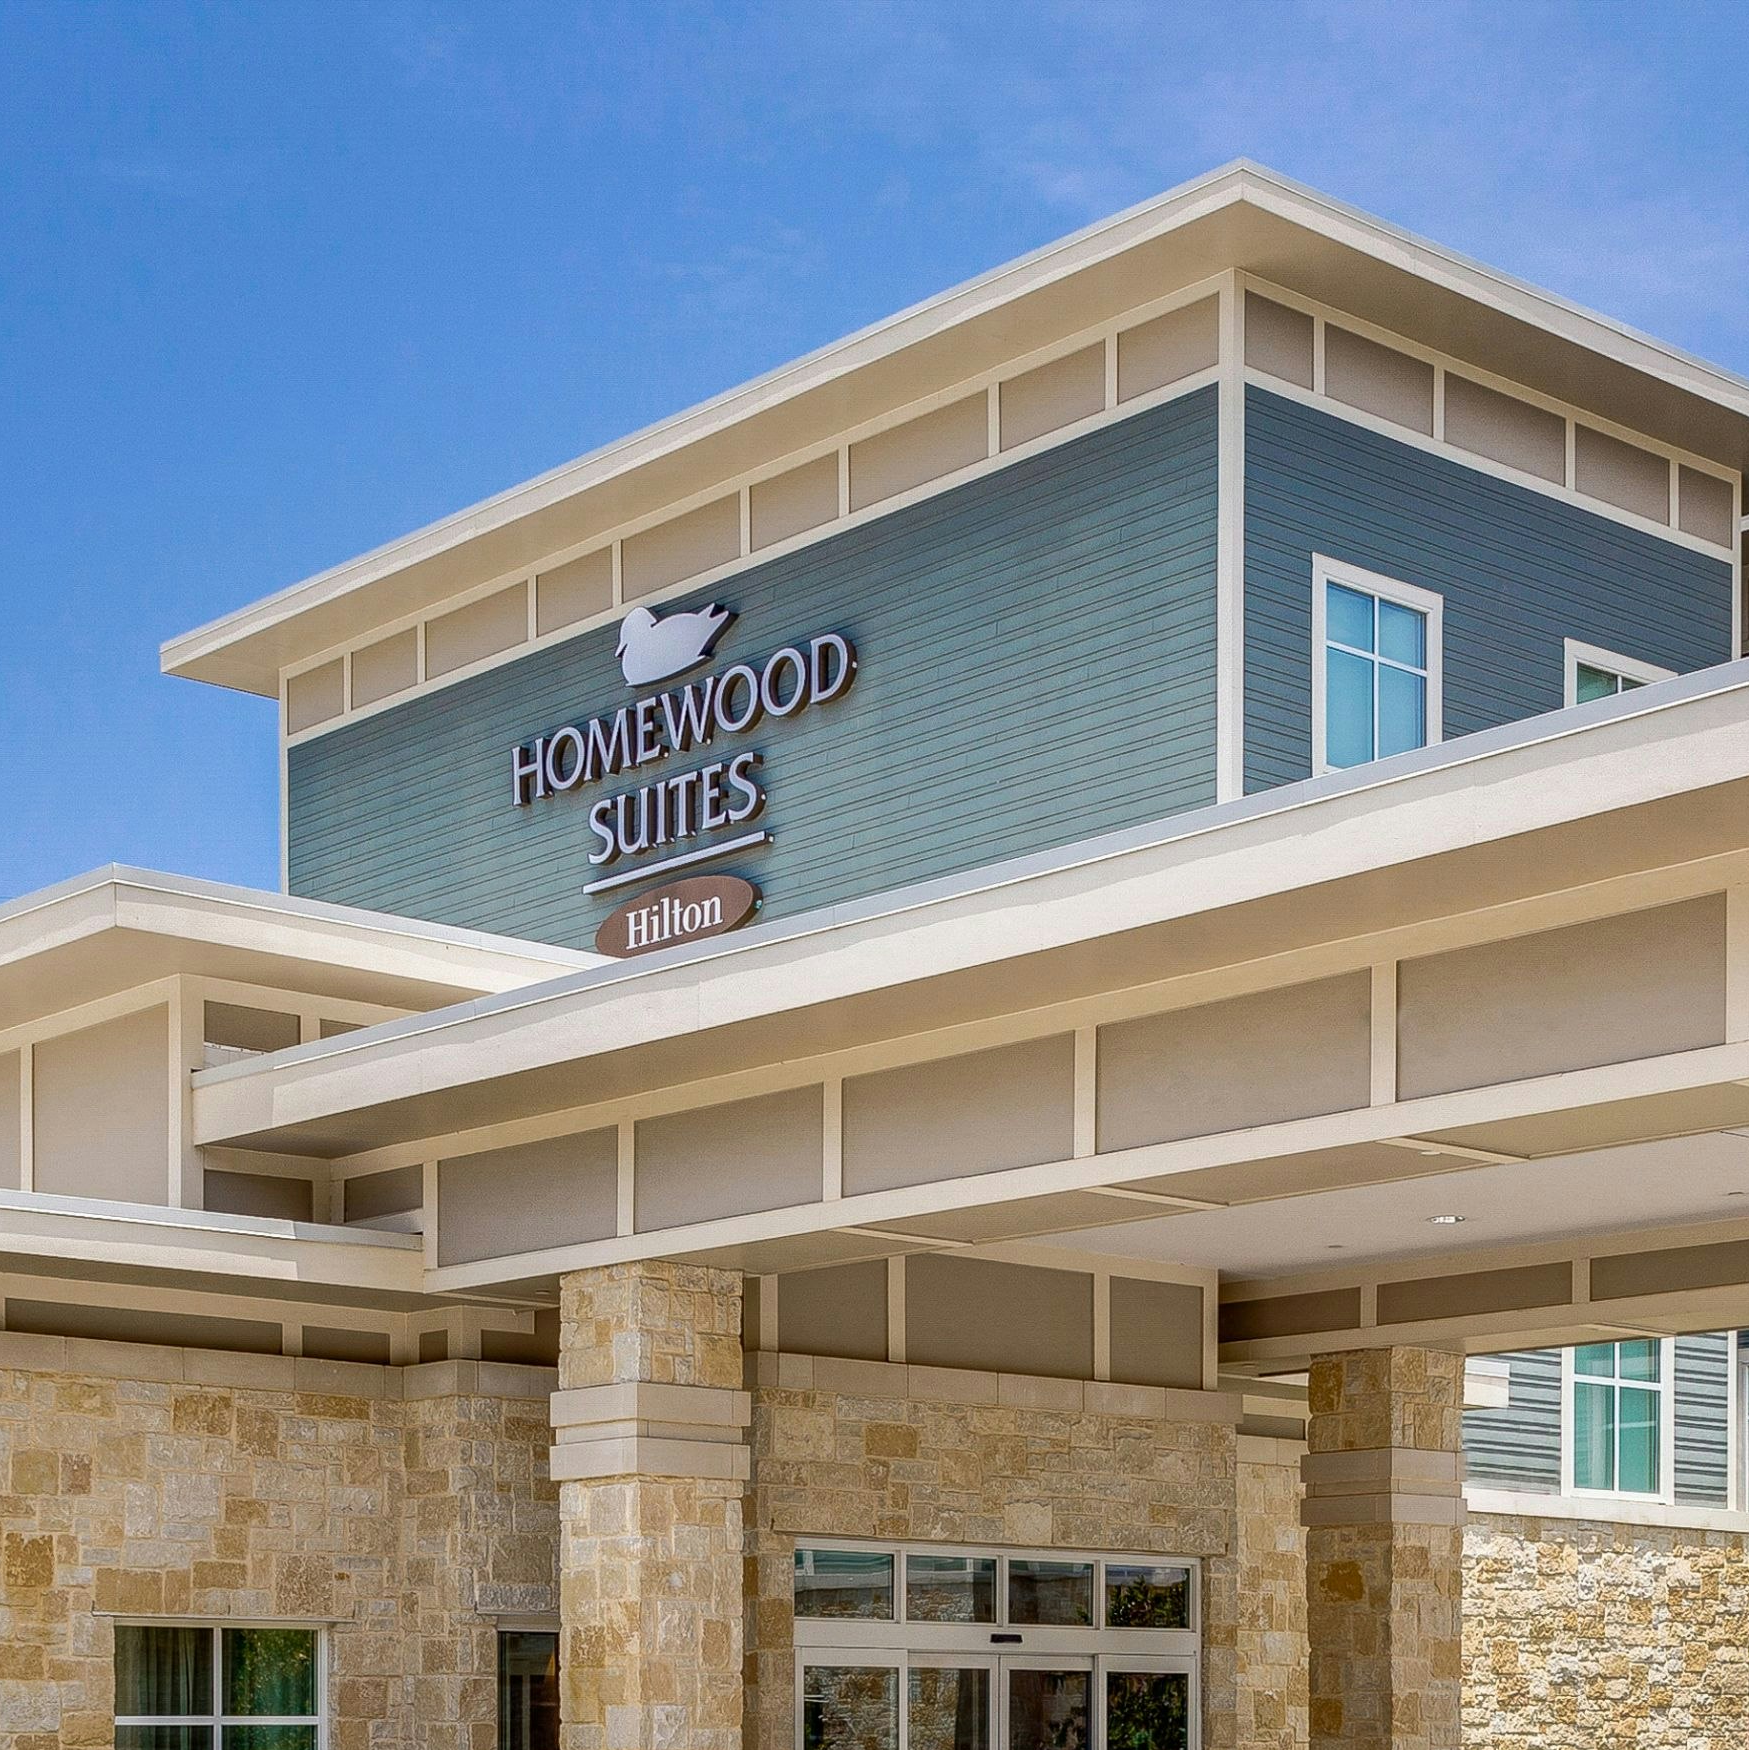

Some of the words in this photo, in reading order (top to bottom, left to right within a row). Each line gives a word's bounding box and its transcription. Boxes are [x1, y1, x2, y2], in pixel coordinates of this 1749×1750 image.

[511, 633, 856, 806] HOMEWOOD
[587, 752, 765, 865] SUITES
[625, 895, 724, 951] Hilton
